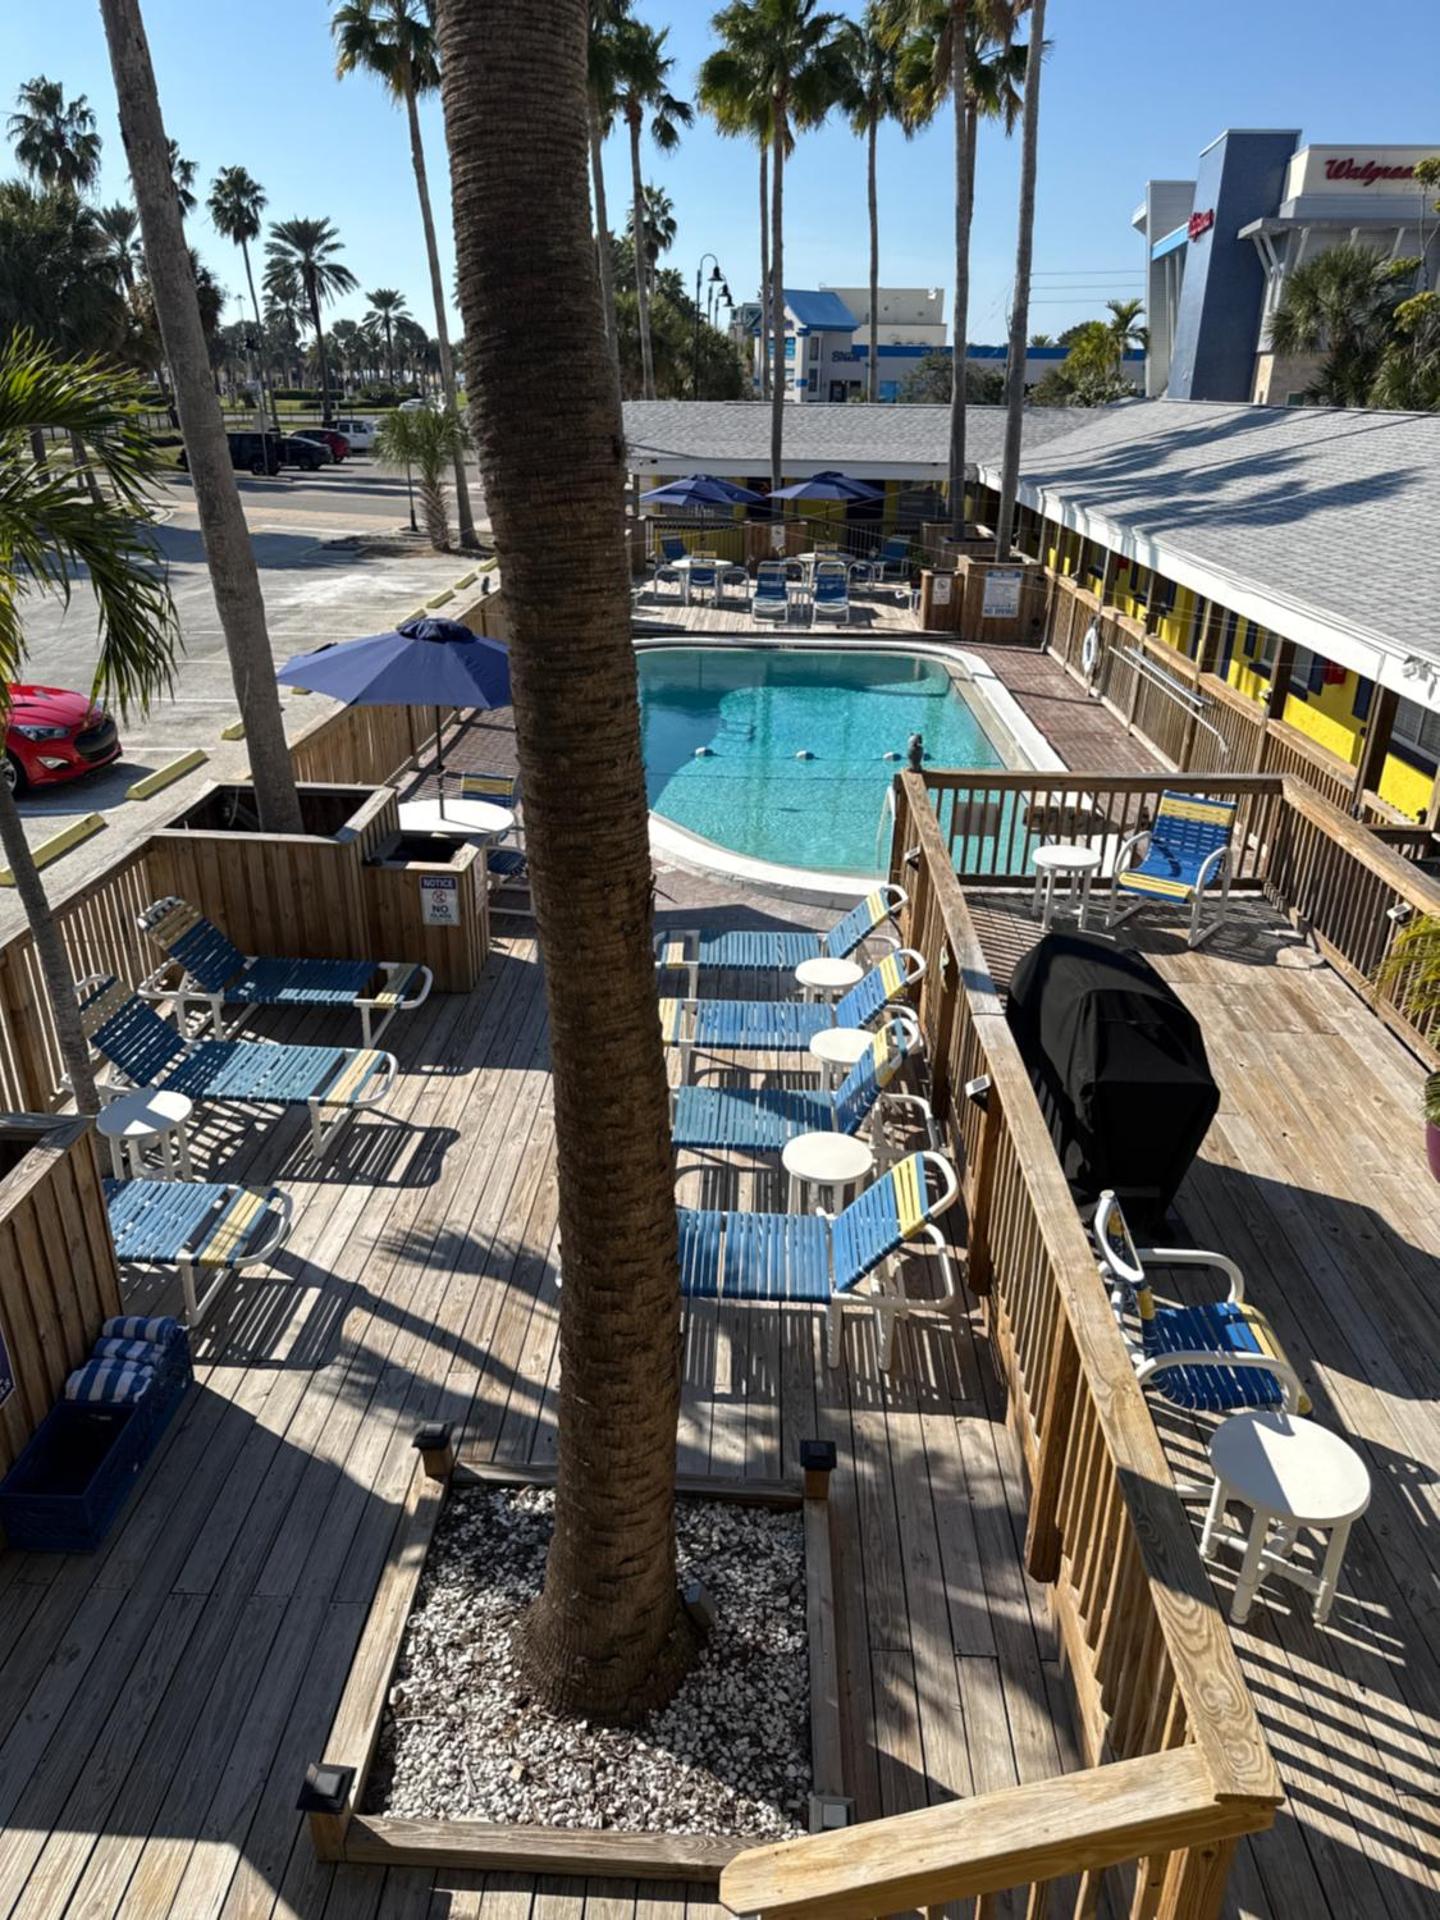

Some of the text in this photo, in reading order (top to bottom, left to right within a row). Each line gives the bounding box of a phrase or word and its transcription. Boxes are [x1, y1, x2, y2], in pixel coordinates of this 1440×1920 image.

[1325, 158, 1415, 187] Walgree
[423, 878, 453, 888] NOTICE
[432, 904, 449, 913] NO
